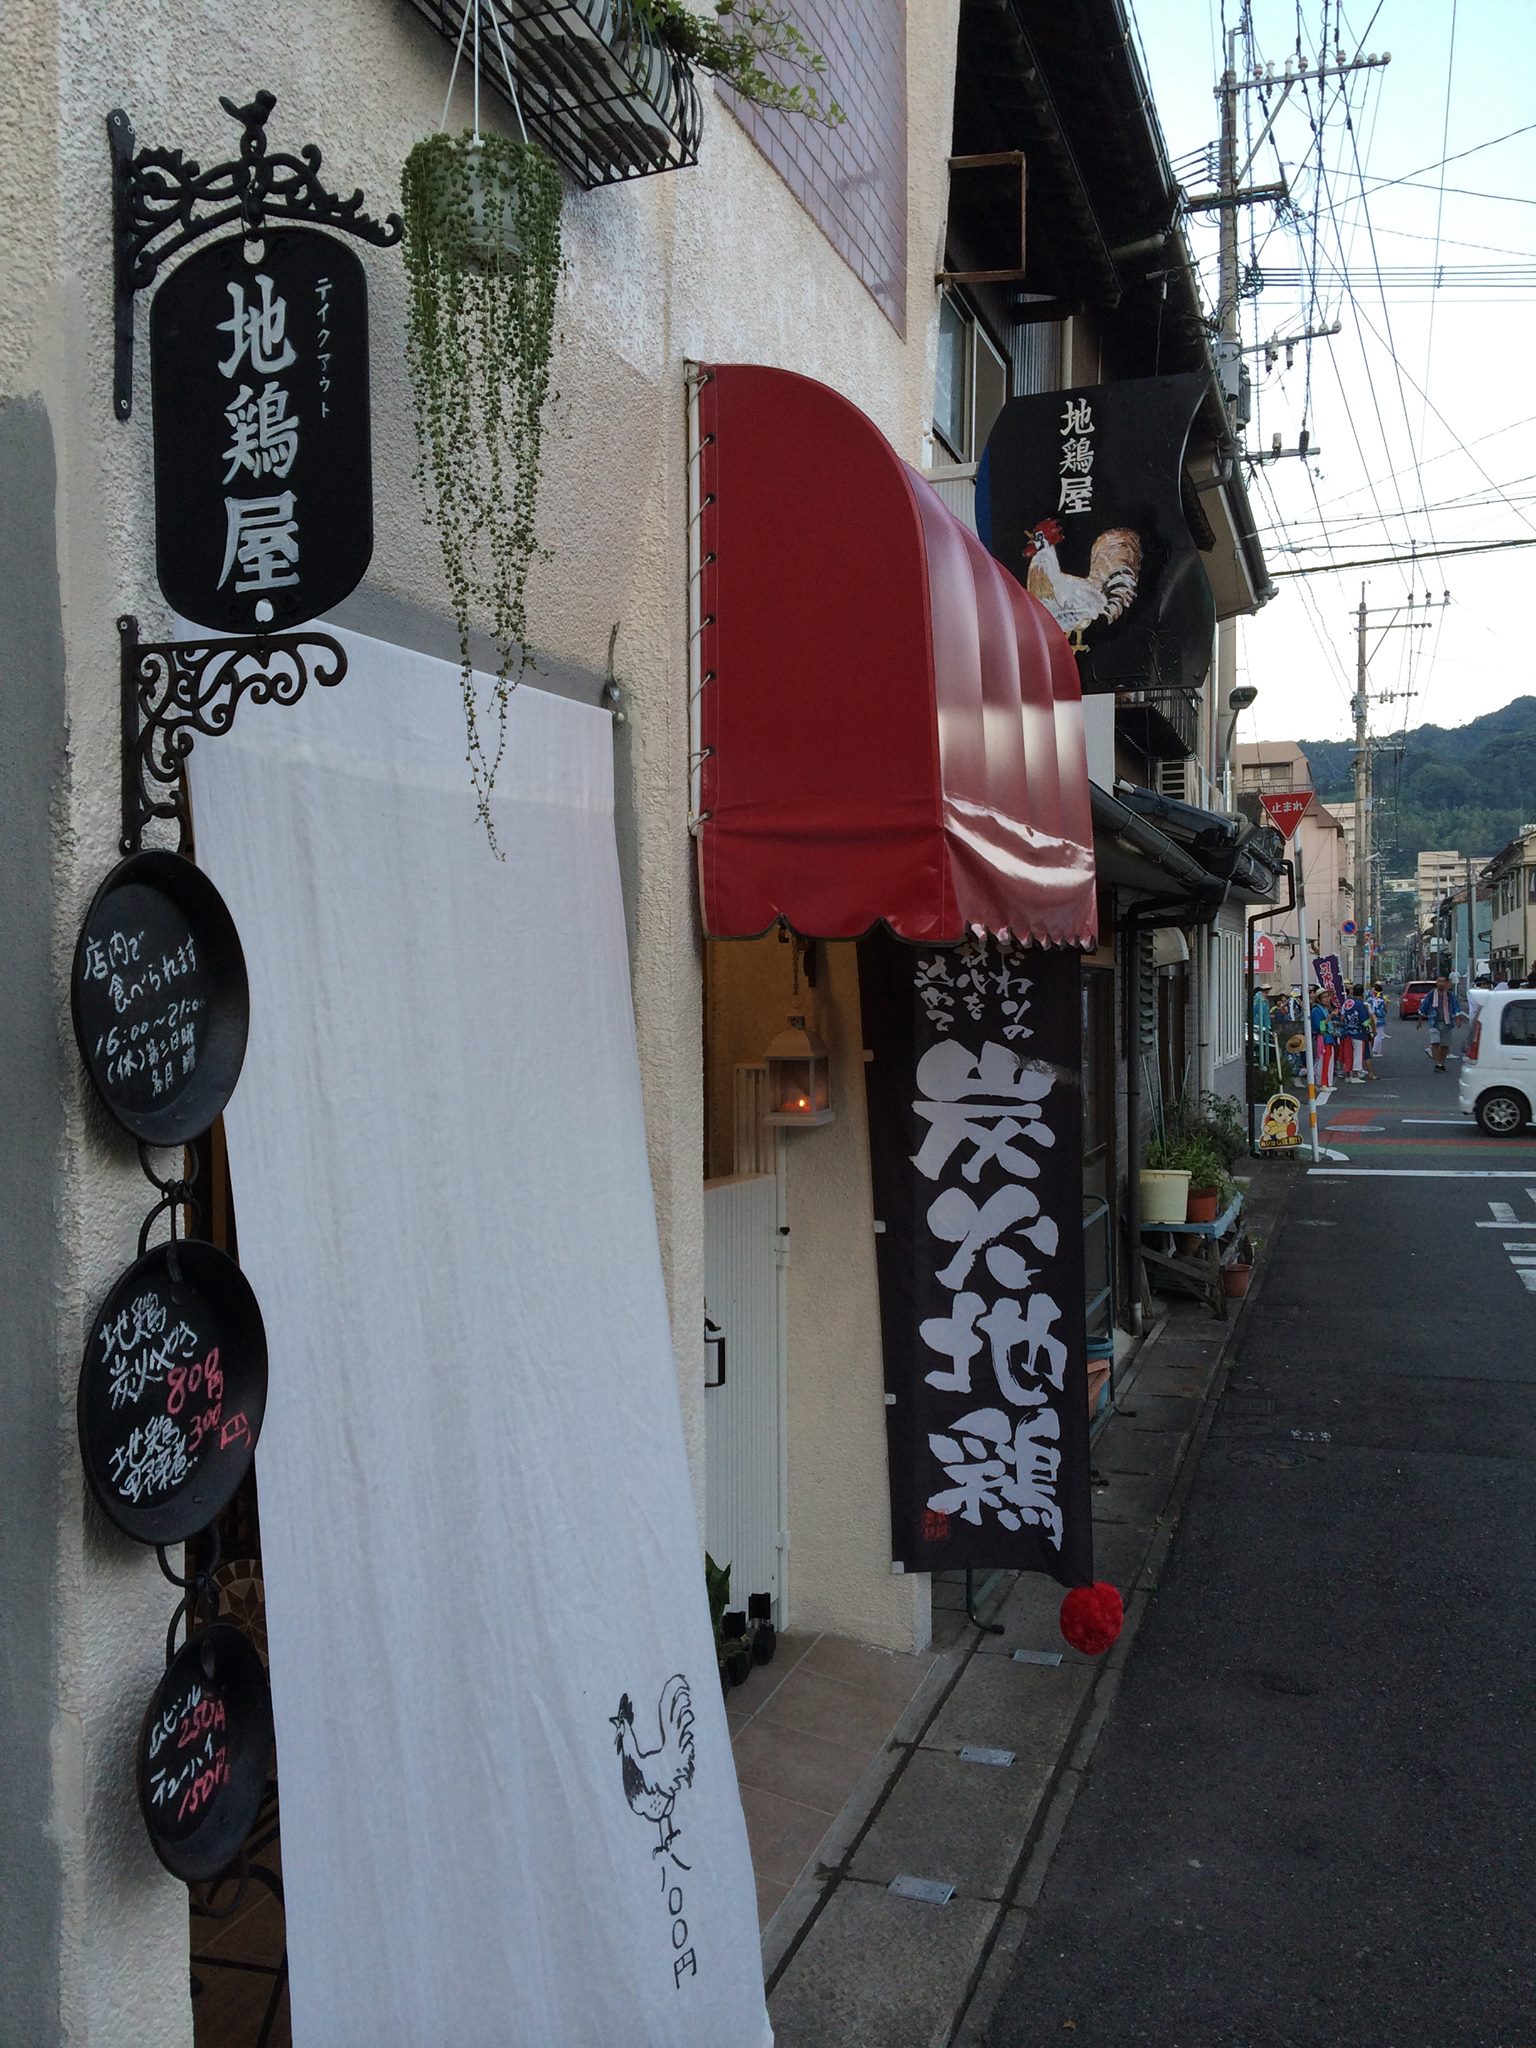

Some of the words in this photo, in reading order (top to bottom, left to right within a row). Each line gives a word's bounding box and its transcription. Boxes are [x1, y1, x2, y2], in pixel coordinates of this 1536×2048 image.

[314, 277, 333, 419] テイクアウト
[216, 274, 300, 594] 地鶏屋
[1058, 398, 1095, 514] 地鶏屋
[1270, 801, 1304, 814] 止まれ
[84, 930, 146, 981] 店内で
[108, 933, 198, 1013] 食べられます
[99, 1292, 167, 1363] 地鶏
[909, 1039, 1068, 1552] 炭火地鶏
